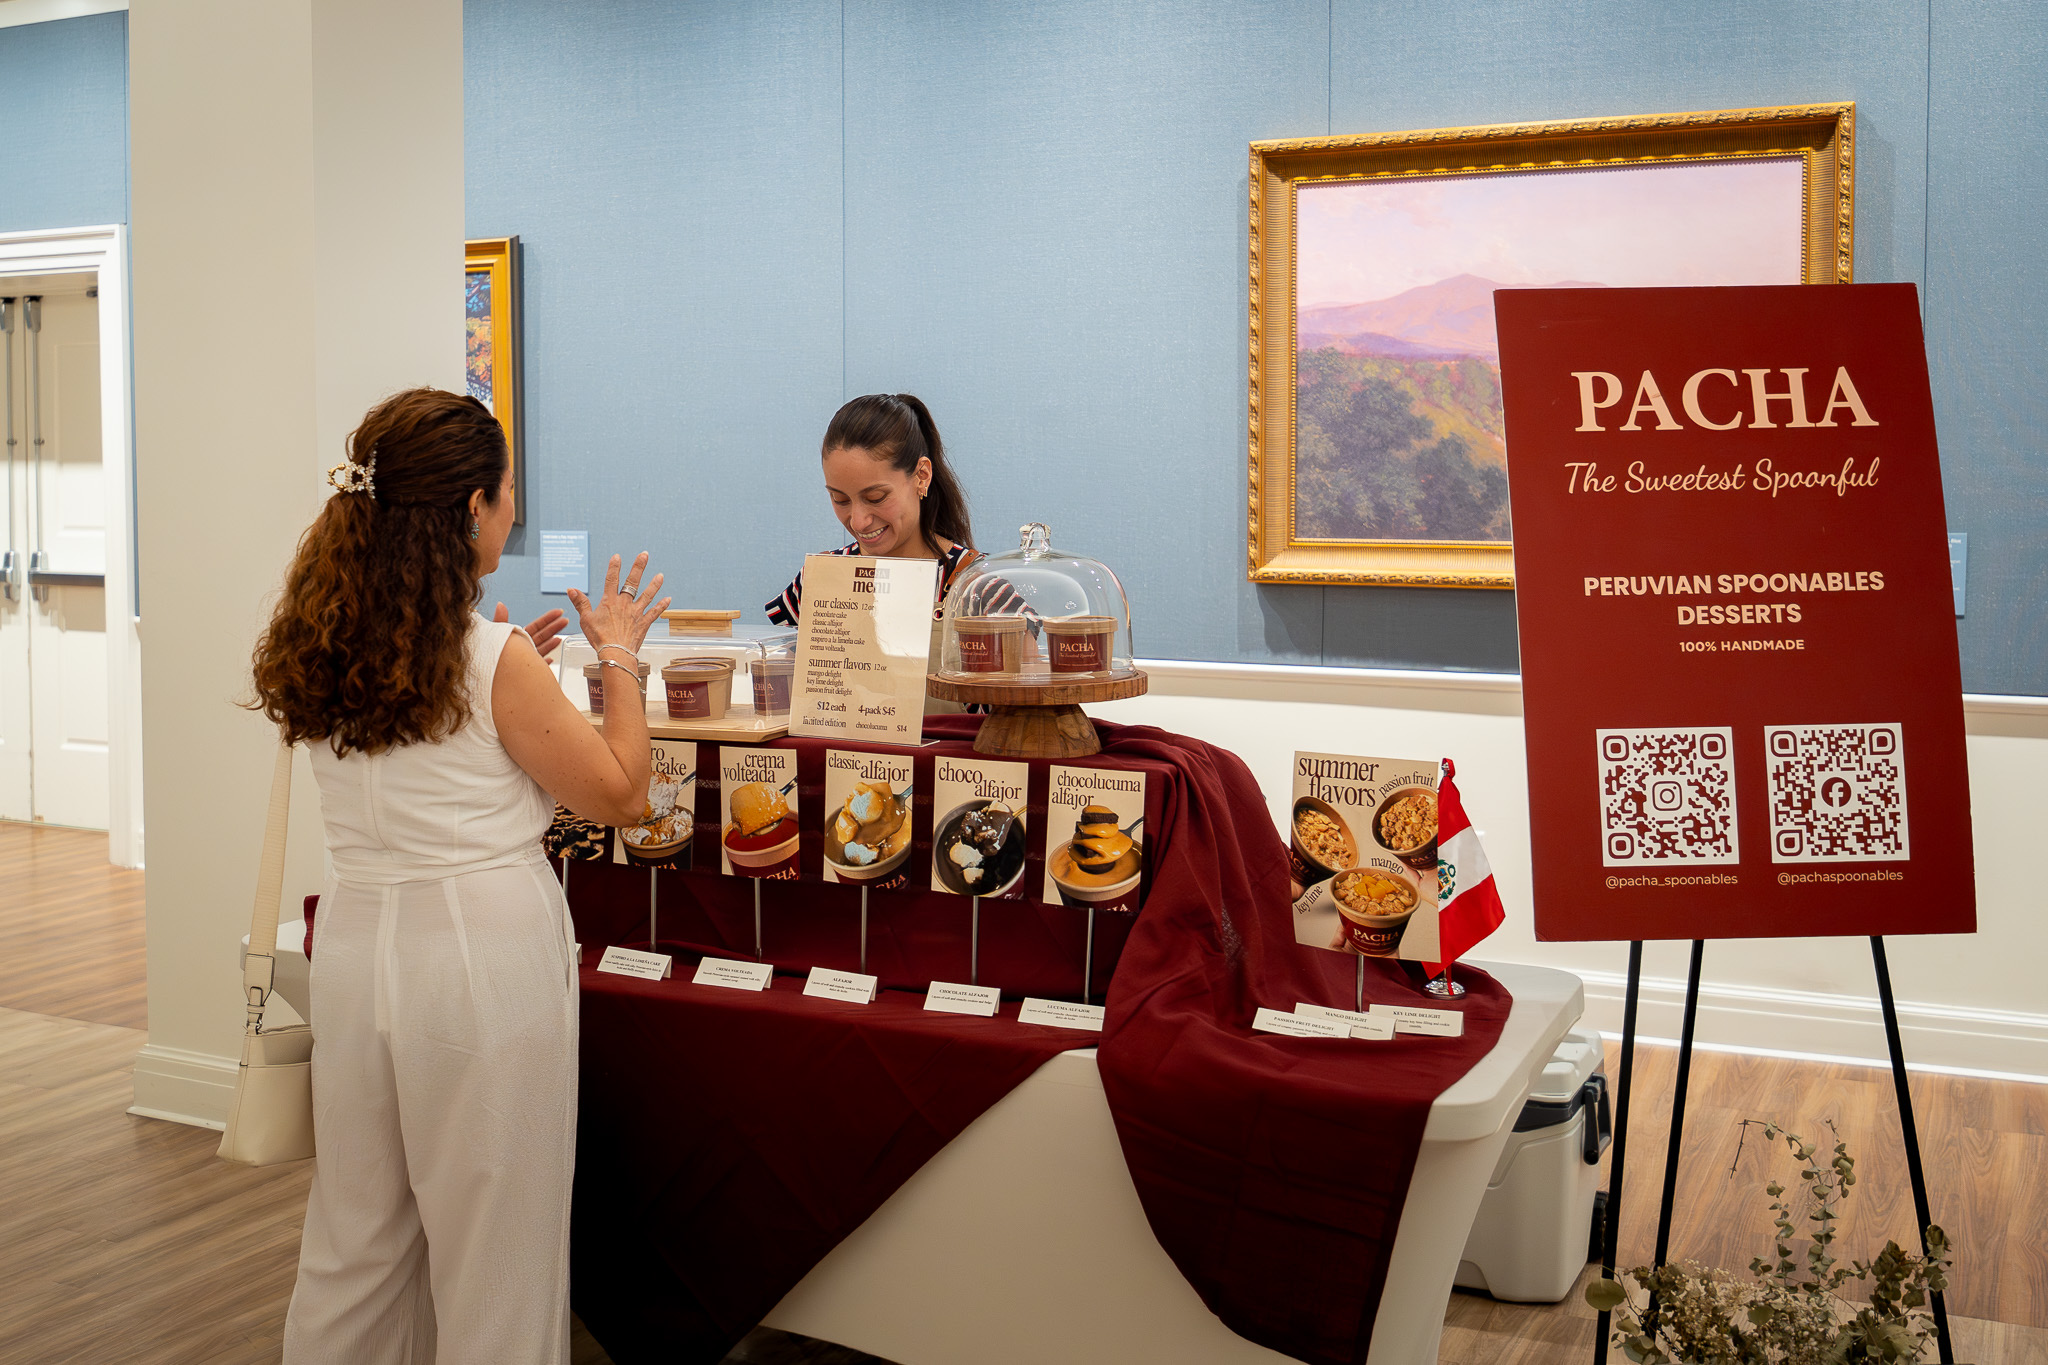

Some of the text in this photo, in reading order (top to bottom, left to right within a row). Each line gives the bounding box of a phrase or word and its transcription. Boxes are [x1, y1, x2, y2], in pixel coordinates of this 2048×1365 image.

[1570, 365, 1880, 432] PACHA
[1564, 456, 1881, 498] The Sweetest Spoonful
[1583, 571, 1885, 597] PERUVIAN SPOONABLES
[813, 599, 829, 609] our
[830, 597, 859, 611] classics
[812, 610, 847, 619] chocolate cake
[812, 618, 843, 628] classic alfajor
[1677, 603, 1802, 626] DESSERTS
[811, 627, 851, 637] chocolate alfajor
[825, 644, 846, 653] volteada
[1060, 642, 1095, 652] PACHA
[1679, 639, 1805, 652] 100% HANDMADE
[808, 658, 842, 669] summer
[843, 657, 872, 671] flavors
[806, 677, 844, 687] key lime delight
[807, 670, 842, 679] mango delight
[589, 685, 603, 694] PAC
[805, 686, 853, 697] passion fruit delight
[816, 700, 896, 717] $12 each 4-pack $45
[802, 715, 824, 726] limited
[825, 717, 847, 728] edition
[896, 724, 907, 732] $14
[656, 757, 687, 776] cake
[744, 753, 786, 769] crema
[828, 752, 861, 771] classic
[1298, 756, 1379, 782] summer
[722, 762, 776, 783] volteada
[860, 760, 910, 784] alfajor
[938, 761, 983, 784] choco
[1057, 770, 1141, 792] chocolucuma
[1378, 770, 1434, 798] passion fruit
[974, 779, 1022, 803] alfajor
[1051, 787, 1095, 810] alfajor
[1308, 774, 1376, 807] flavors
[1370, 857, 1404, 875] mango
[1605, 873, 1738, 889] @pacha_spoonables
[1777, 869, 1904, 885] @pachaspoonables
[1294, 885, 1323, 915] key lime
[1353, 928, 1399, 942] PACHA
